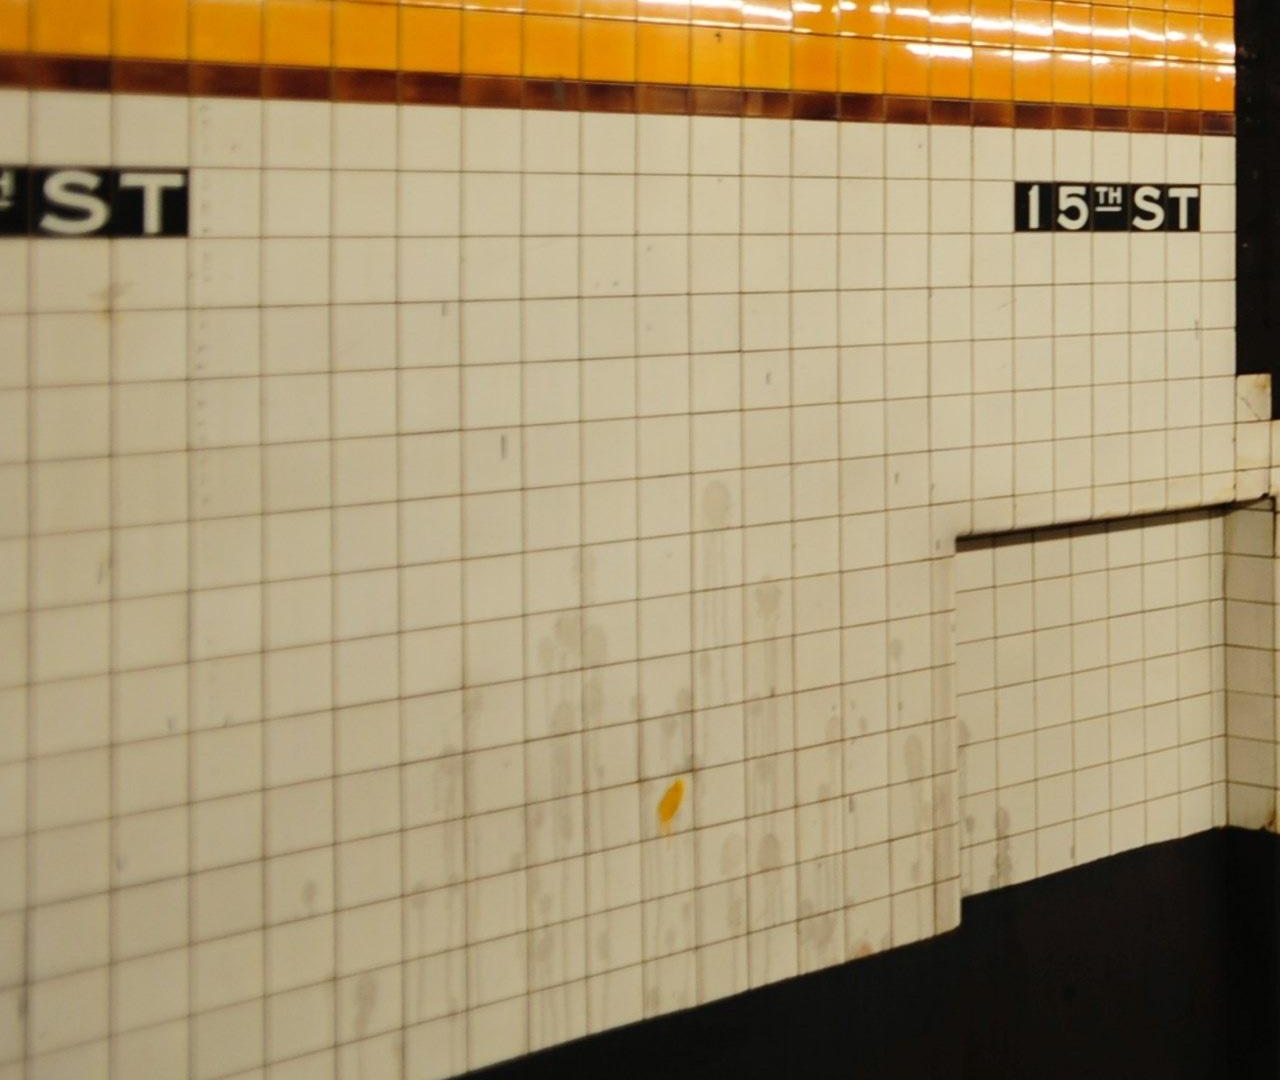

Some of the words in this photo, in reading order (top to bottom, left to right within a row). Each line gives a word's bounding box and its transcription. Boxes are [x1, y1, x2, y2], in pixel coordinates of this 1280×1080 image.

[39, 170, 185, 235] ST
[1028, 184, 1122, 230] 15TH
[1132, 185, 1199, 230] ST
